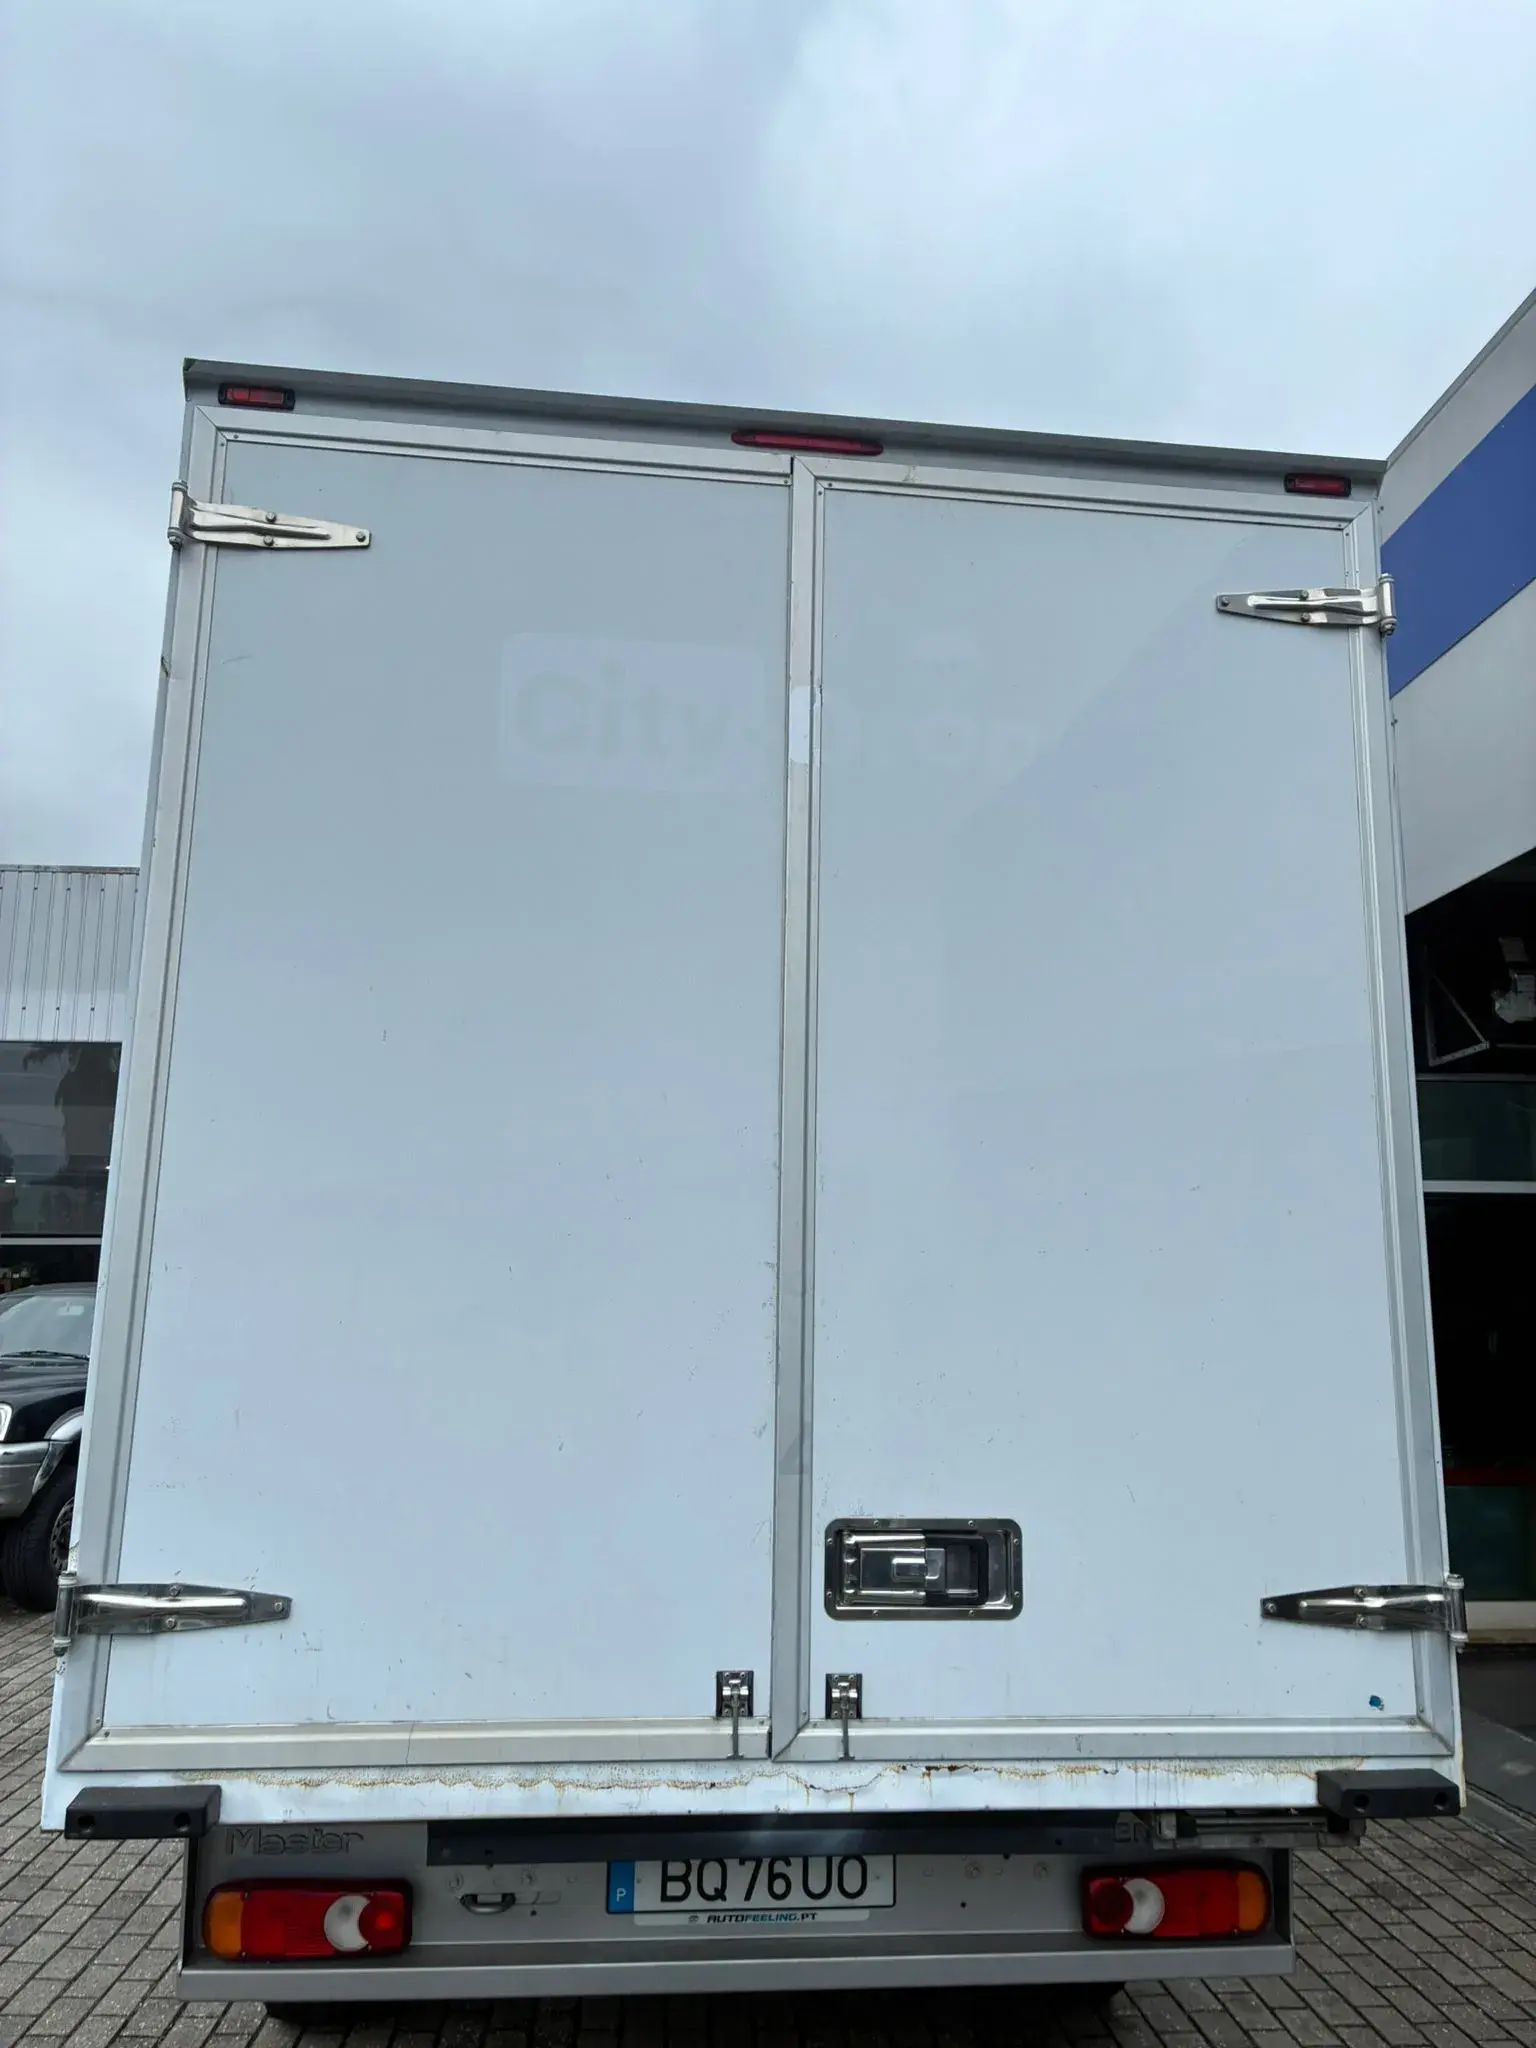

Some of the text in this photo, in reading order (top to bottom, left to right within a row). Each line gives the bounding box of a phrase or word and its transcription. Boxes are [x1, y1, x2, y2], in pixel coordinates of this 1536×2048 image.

[226, 1827, 364, 1855] Master
[616, 1888, 626, 1901] P
[707, 1912, 818, 1924] AUTOFEELING.PT
